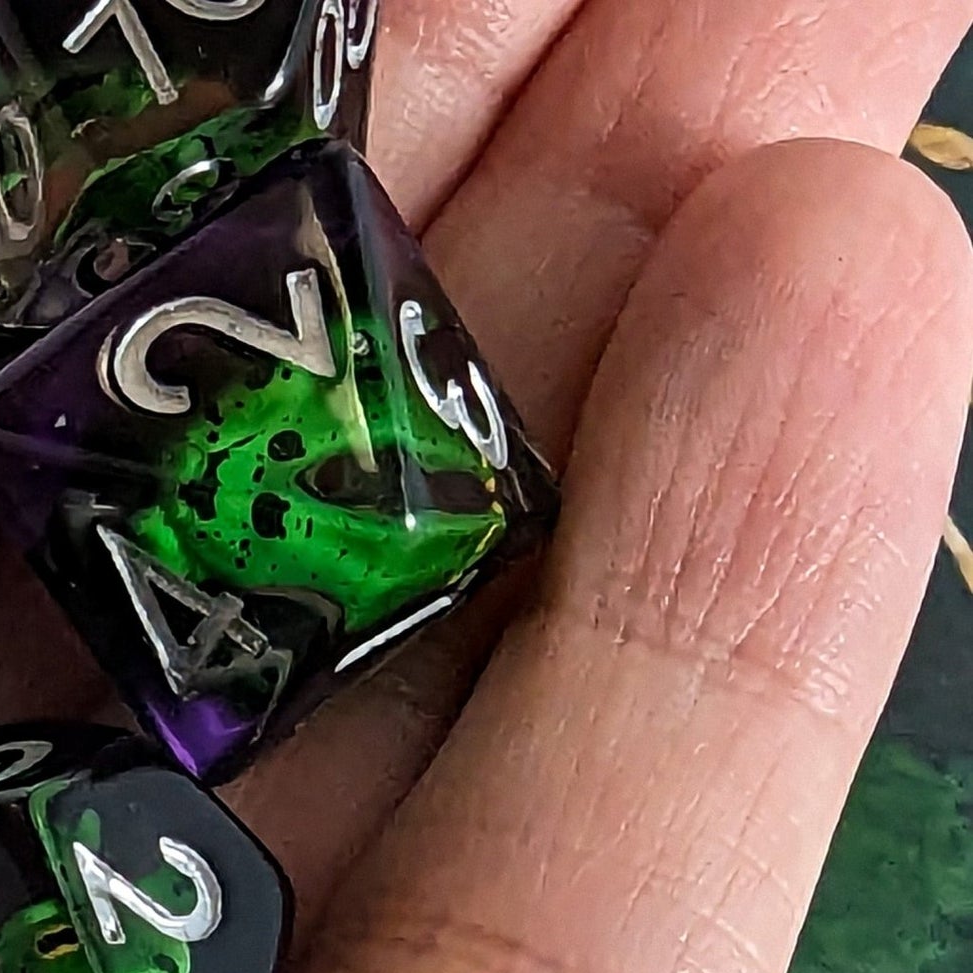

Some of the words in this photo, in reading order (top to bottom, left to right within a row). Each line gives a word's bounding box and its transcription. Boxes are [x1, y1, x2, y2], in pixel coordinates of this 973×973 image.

[99, 267, 337, 415] 2
[95, 522, 275, 701] 4
[72, 835, 223, 946] 2
